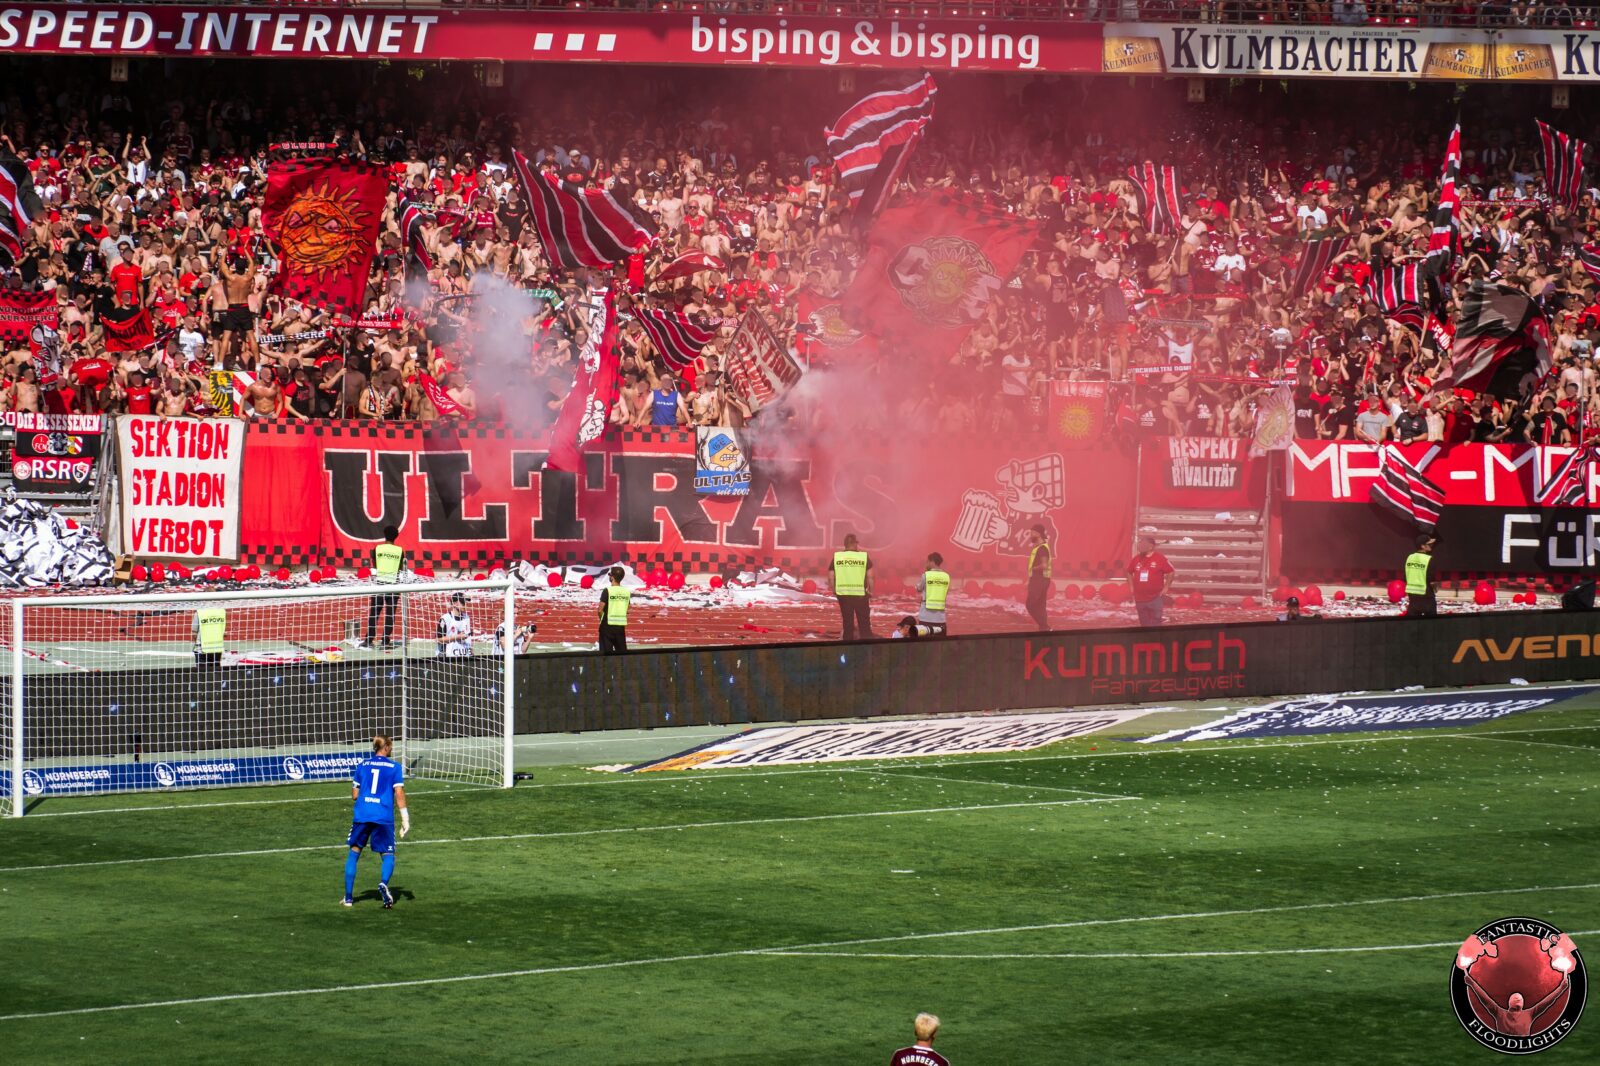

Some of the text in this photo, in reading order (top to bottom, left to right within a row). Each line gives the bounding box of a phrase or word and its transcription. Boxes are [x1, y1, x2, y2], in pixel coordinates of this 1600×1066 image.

[0, 9, 438, 53] SPEED-INTERNET
[691, 16, 1040, 69] bisping & bisping
[1103, 52, 1160, 71] KULMBACHER
[1171, 27, 1417, 73] KULMBACHER
[1493, 58, 1551, 78] KULMBACHER
[16, 411, 101, 431] DIE BESESSENEN
[130, 418, 230, 461] SEKTION
[1168, 436, 1241, 460] RESPEKT
[32, 459, 71, 480] RSR
[693, 471, 752, 489] ULTRAS
[1171, 463, 1237, 487] RIVALITÄT
[132, 468, 226, 509] STADION
[323, 448, 900, 552] ULTRAS
[131, 517, 224, 557] VERBOT
[1023, 631, 1247, 681] kummich
[1090, 671, 1246, 696] Fahrzeugwelt
[176, 763, 236, 775] NÜRNBERGER
[306, 757, 364, 769] NÜRNBERGER
[44, 769, 111, 782] NÜRNBERGER
[371, 768, 380, 795] 1
